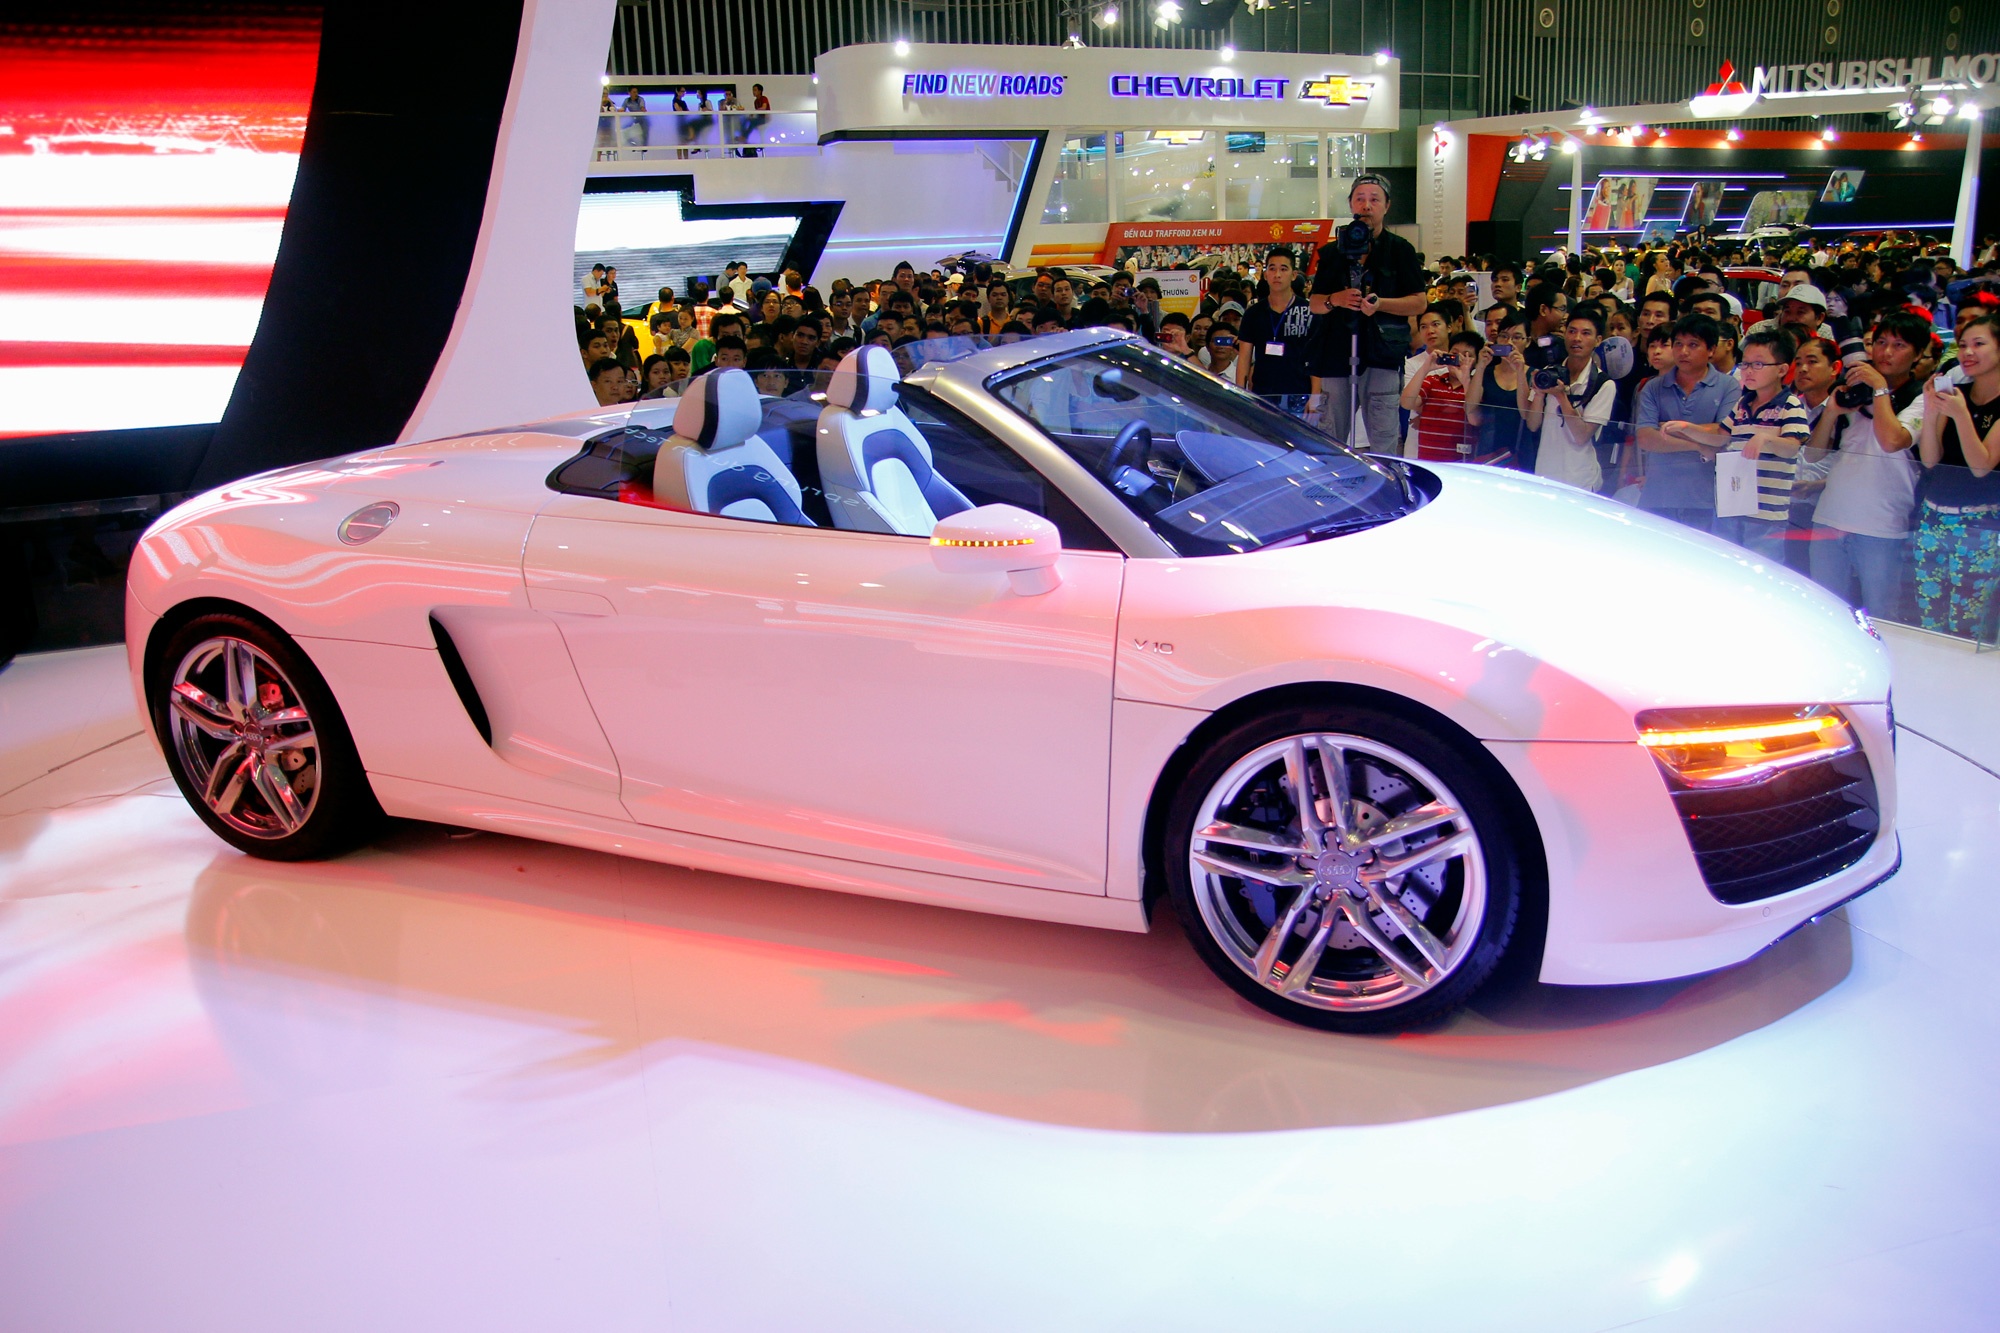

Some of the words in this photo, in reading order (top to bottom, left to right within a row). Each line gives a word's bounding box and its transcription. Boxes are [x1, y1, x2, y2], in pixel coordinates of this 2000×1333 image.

[902, 73, 948, 95] FIND
[950, 73, 998, 95] NEW
[999, 75, 1064, 96] ROADS
[1752, 56, 1931, 94] MITSUBISHI
[1110, 75, 1290, 99] CHEVROLET
[1139, 229, 1153, 238] OLD
[1155, 229, 1190, 238] TRAFFORD
[1192, 228, 1208, 237] XEM
[1208, 228, 1223, 237] M.U
[1134, 638, 1174, 655] V10
